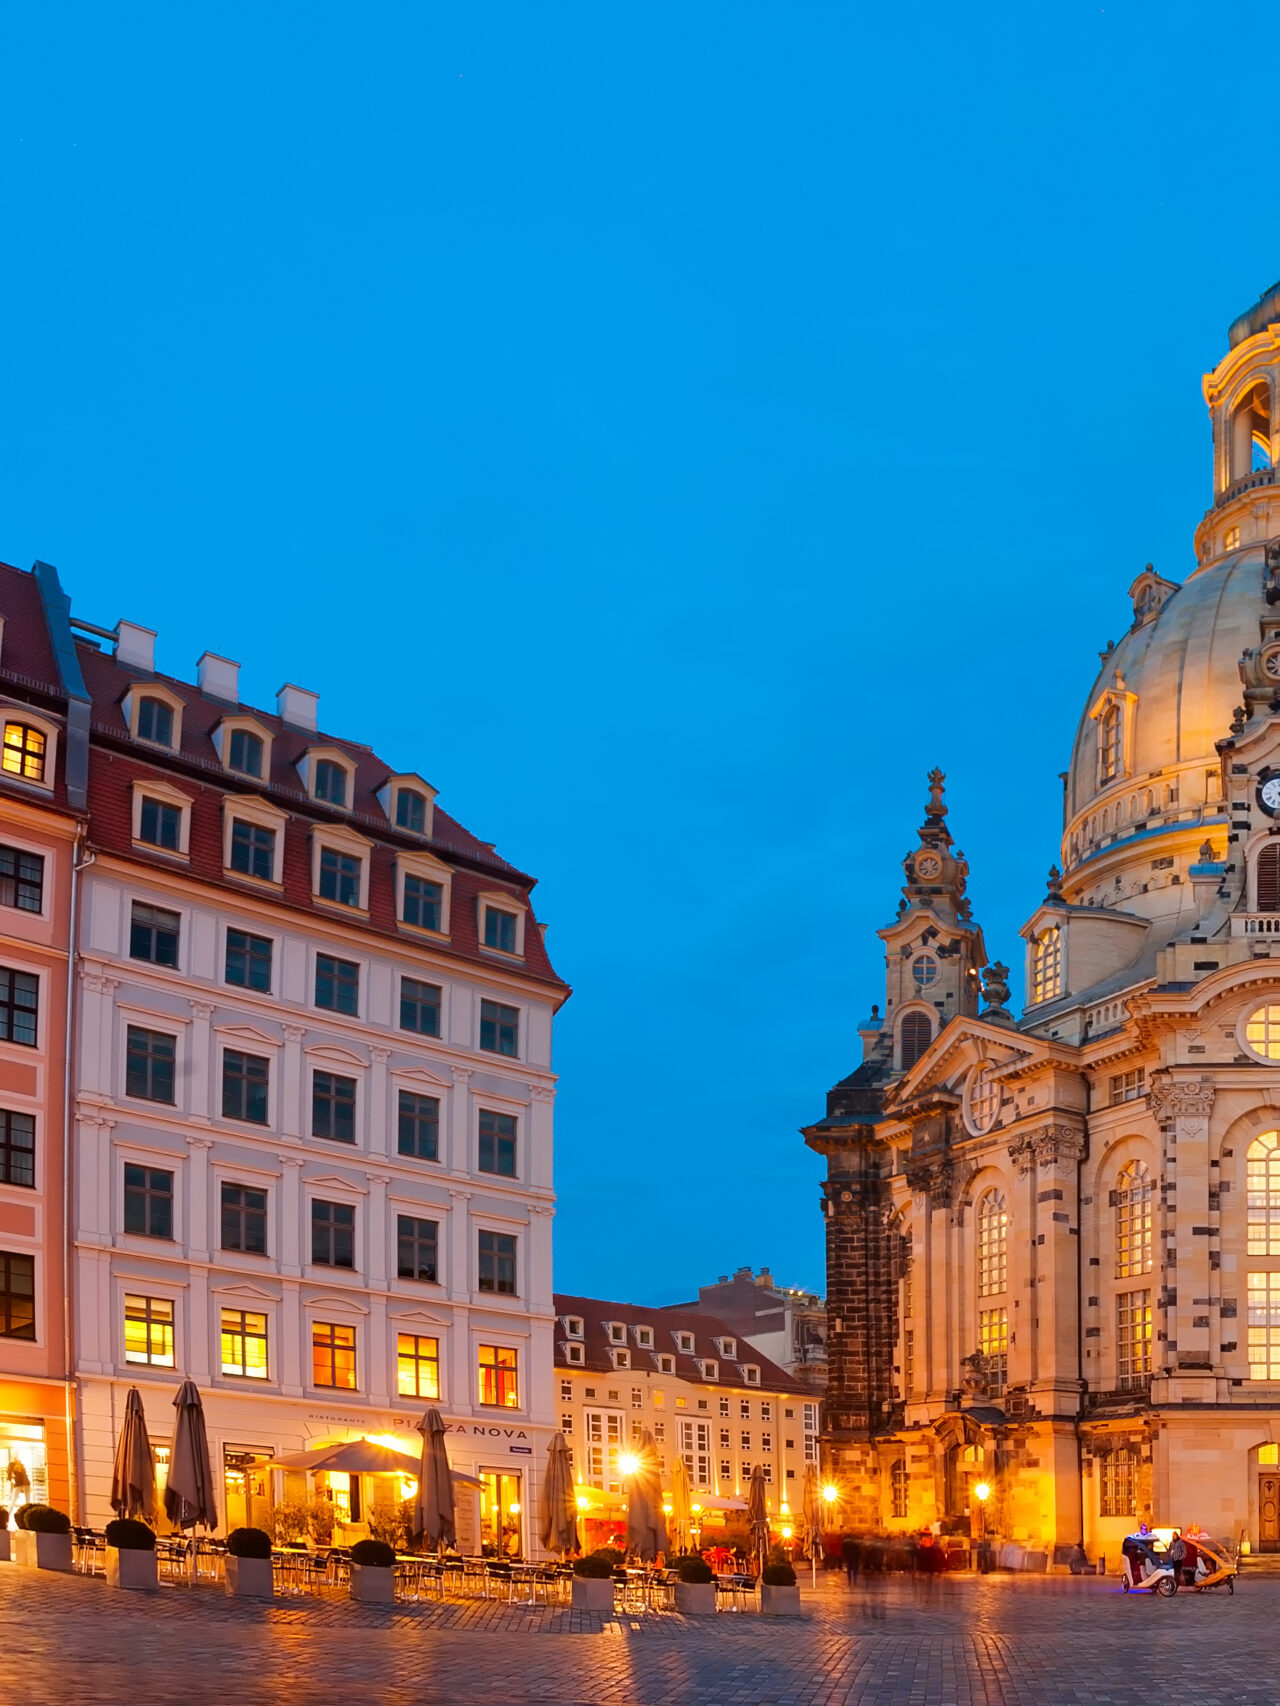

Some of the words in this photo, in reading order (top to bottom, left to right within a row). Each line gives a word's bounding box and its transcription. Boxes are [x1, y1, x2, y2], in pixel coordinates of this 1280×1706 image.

[309, 1414, 365, 1423] RISTORANTE
[393, 1418, 467, 1433] PIZA
[473, 1426, 527, 1439] NOVA
